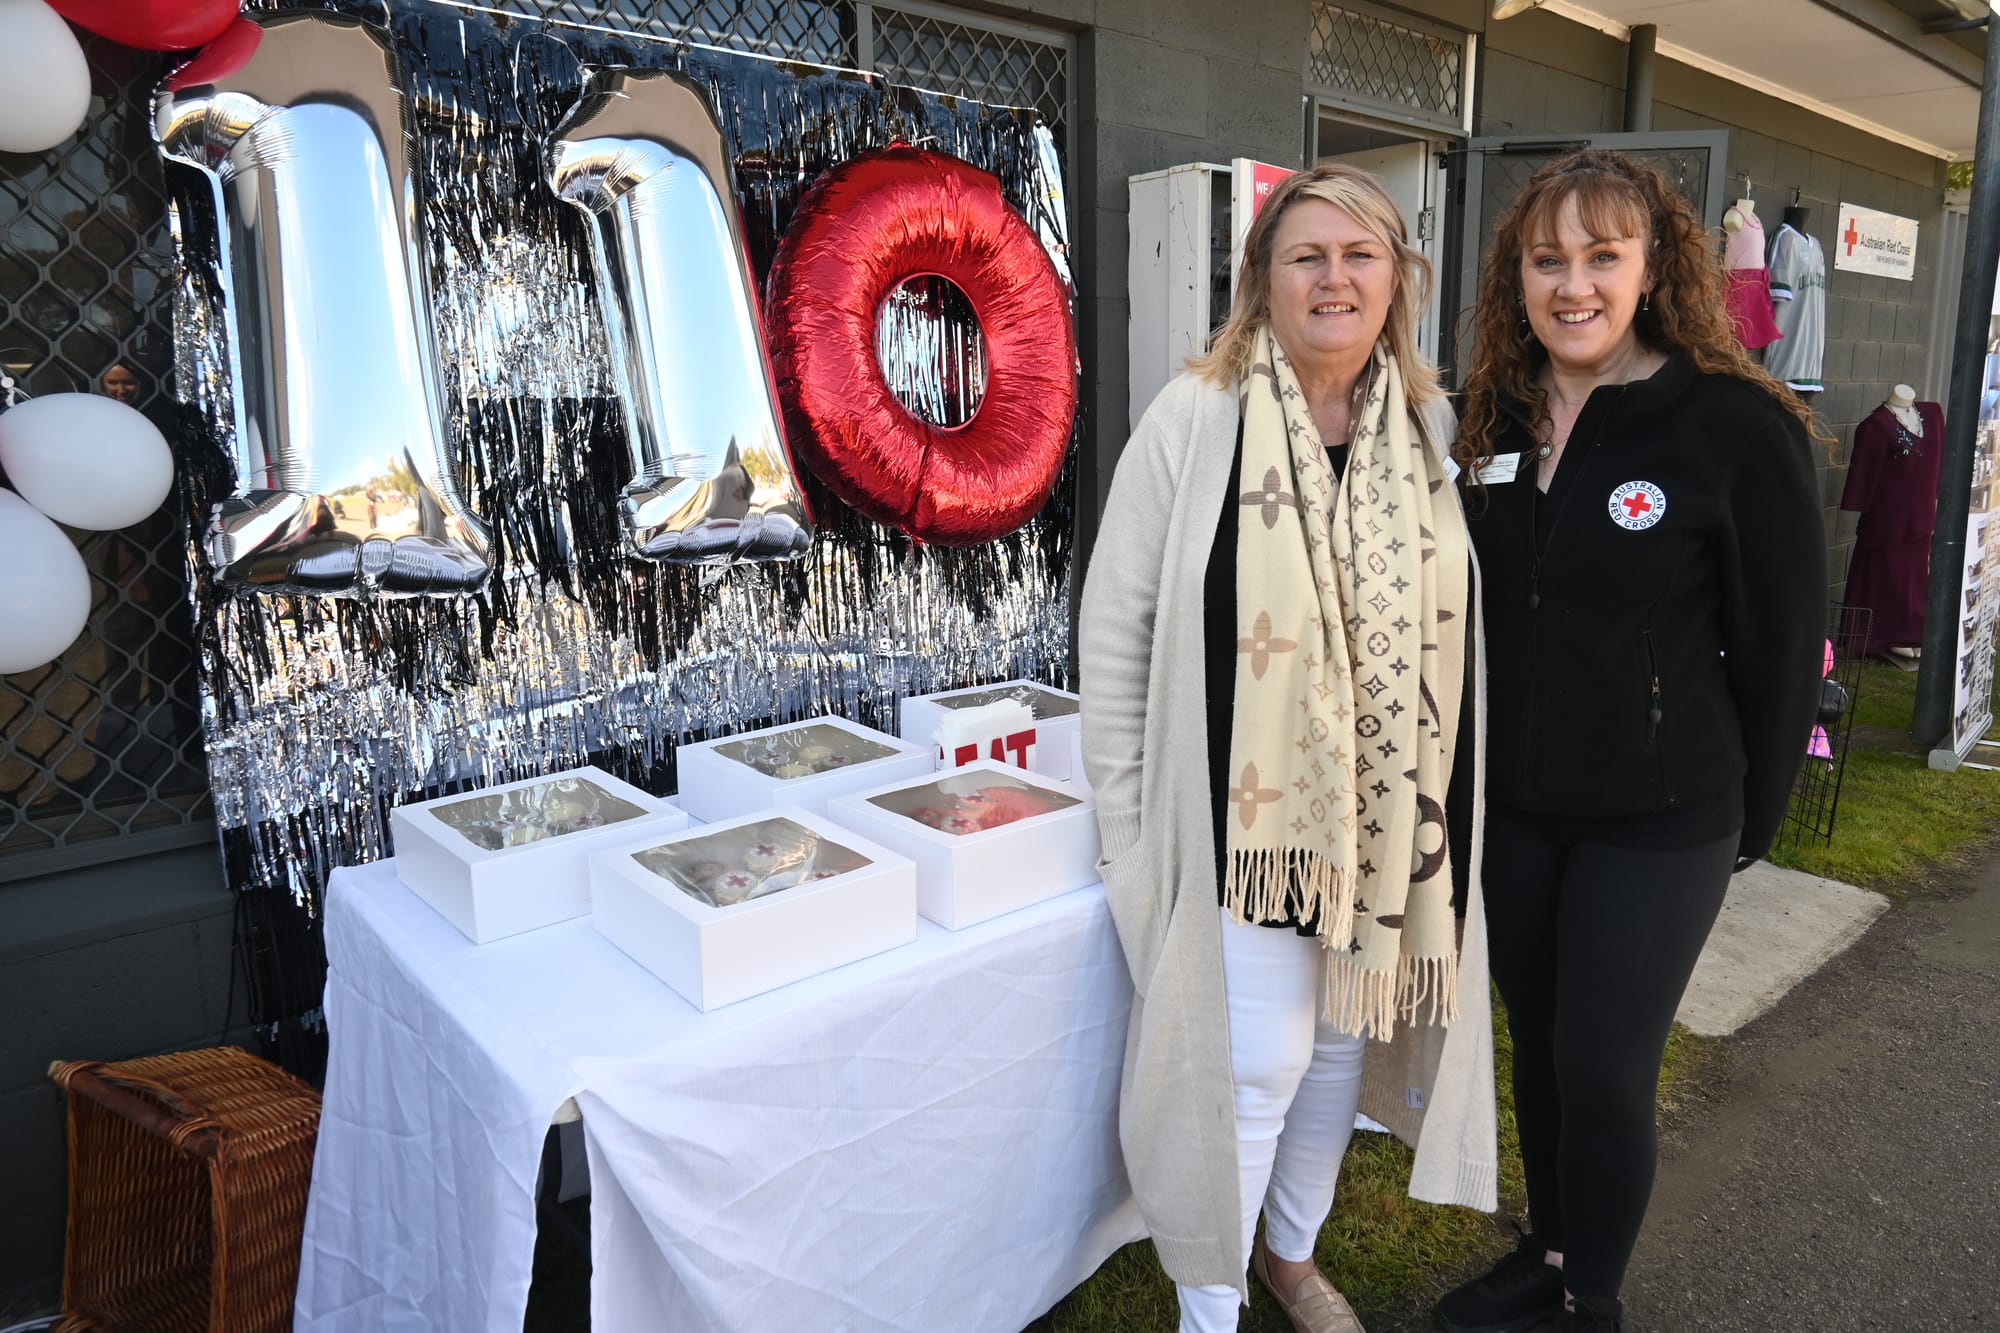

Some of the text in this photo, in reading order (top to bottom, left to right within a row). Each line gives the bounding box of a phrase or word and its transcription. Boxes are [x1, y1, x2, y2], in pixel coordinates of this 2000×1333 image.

[1256, 181, 1269, 195] WE
[1860, 234, 1911, 256] Australian Red Cross
[1613, 482, 1664, 510] AUSTRALIAN
[1610, 502, 1660, 529] RED CROSS
